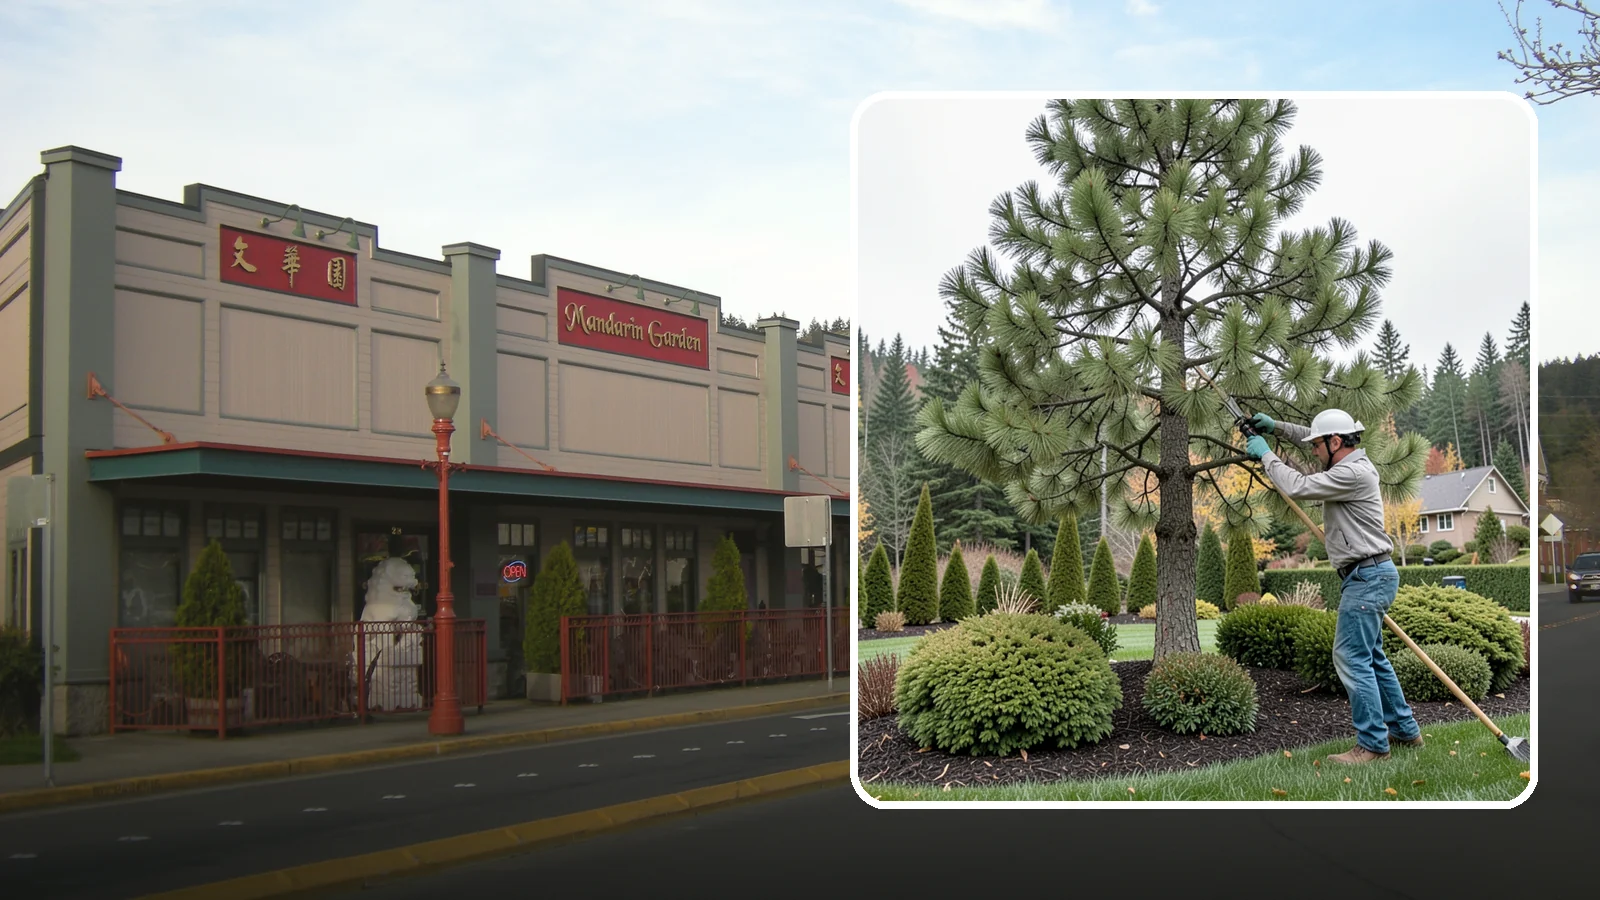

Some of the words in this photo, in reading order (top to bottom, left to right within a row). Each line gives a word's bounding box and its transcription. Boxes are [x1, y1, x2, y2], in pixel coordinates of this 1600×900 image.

[231, 235, 346, 291] 文華園
[565, 302, 644, 341] Mandarin
[648, 320, 701, 352] Garden
[503, 565, 527, 578] OPEN
